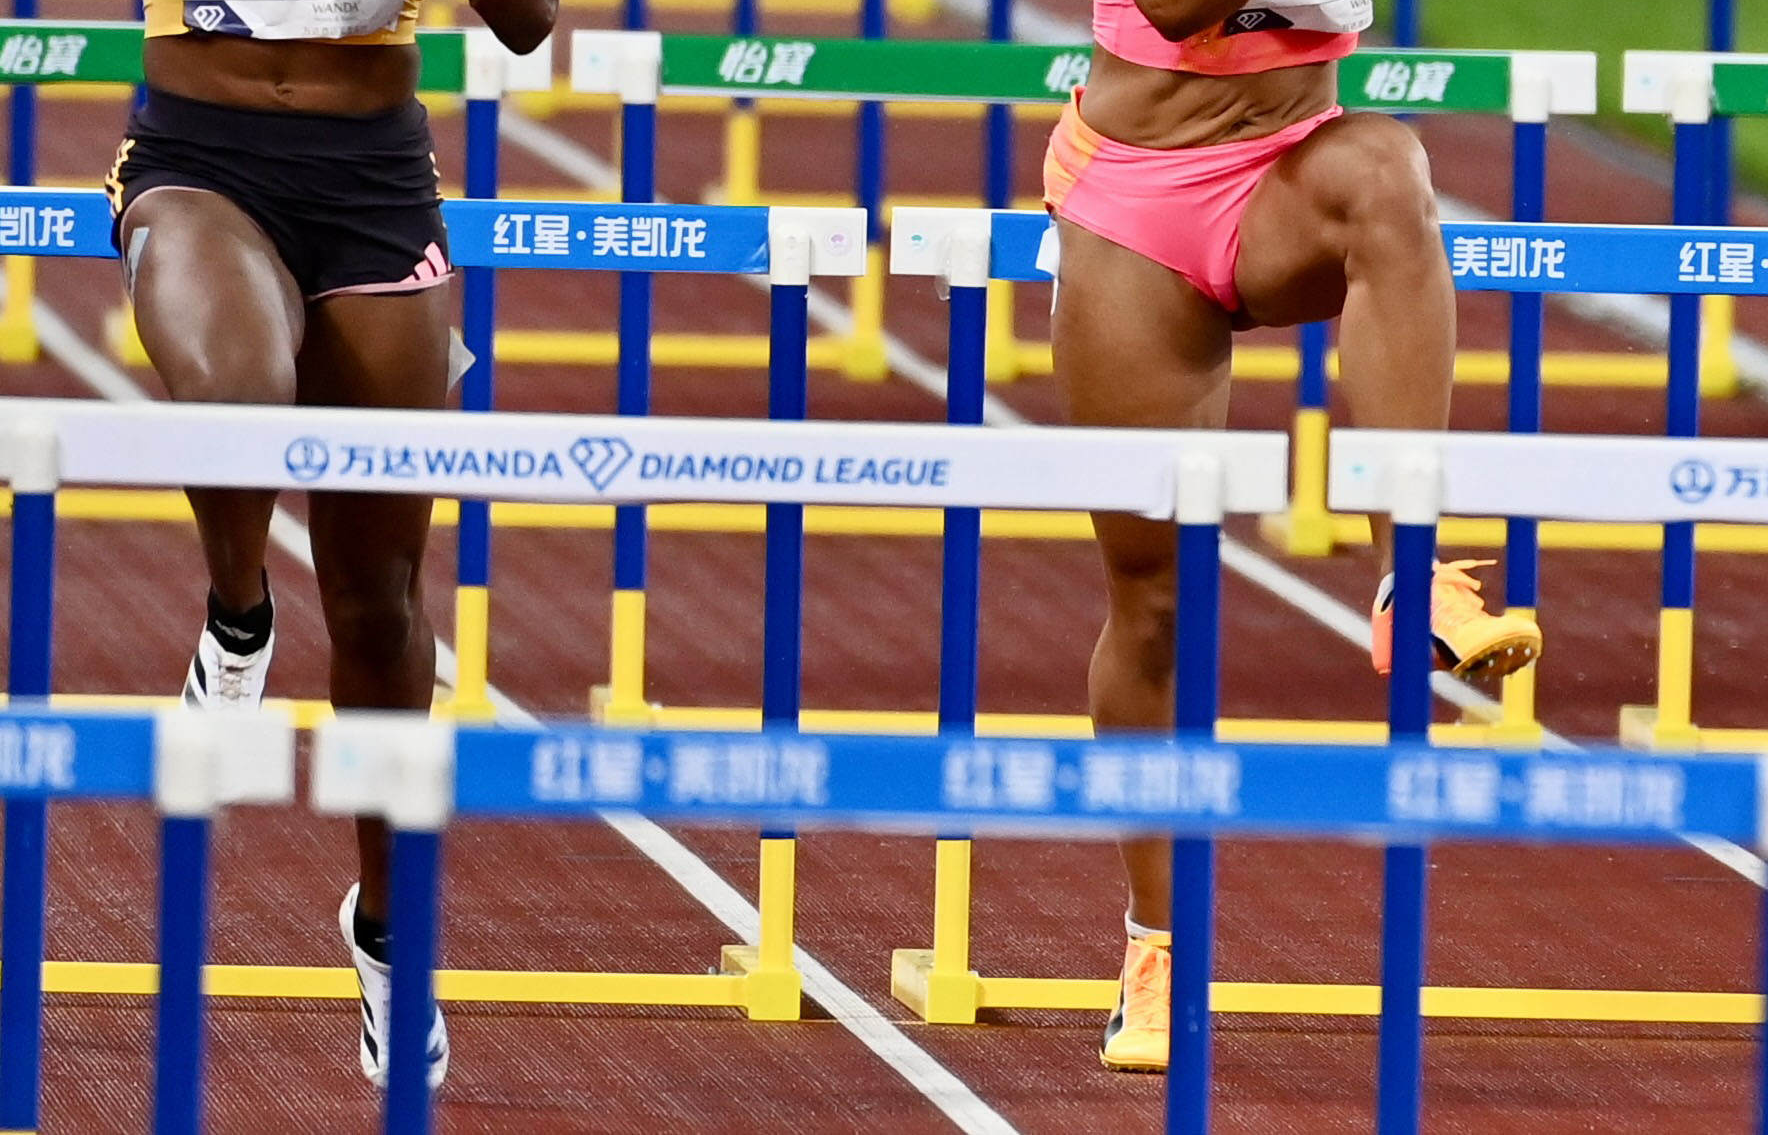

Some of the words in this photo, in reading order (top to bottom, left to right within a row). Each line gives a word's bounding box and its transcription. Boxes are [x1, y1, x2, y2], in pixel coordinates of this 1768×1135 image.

[492, 213, 707, 260] 红星·美凯龙
[1452, 236, 1567, 279] 美凯龙
[640, 452, 802, 486] DIAMOND
[814, 456, 951, 487] LEAGUE
